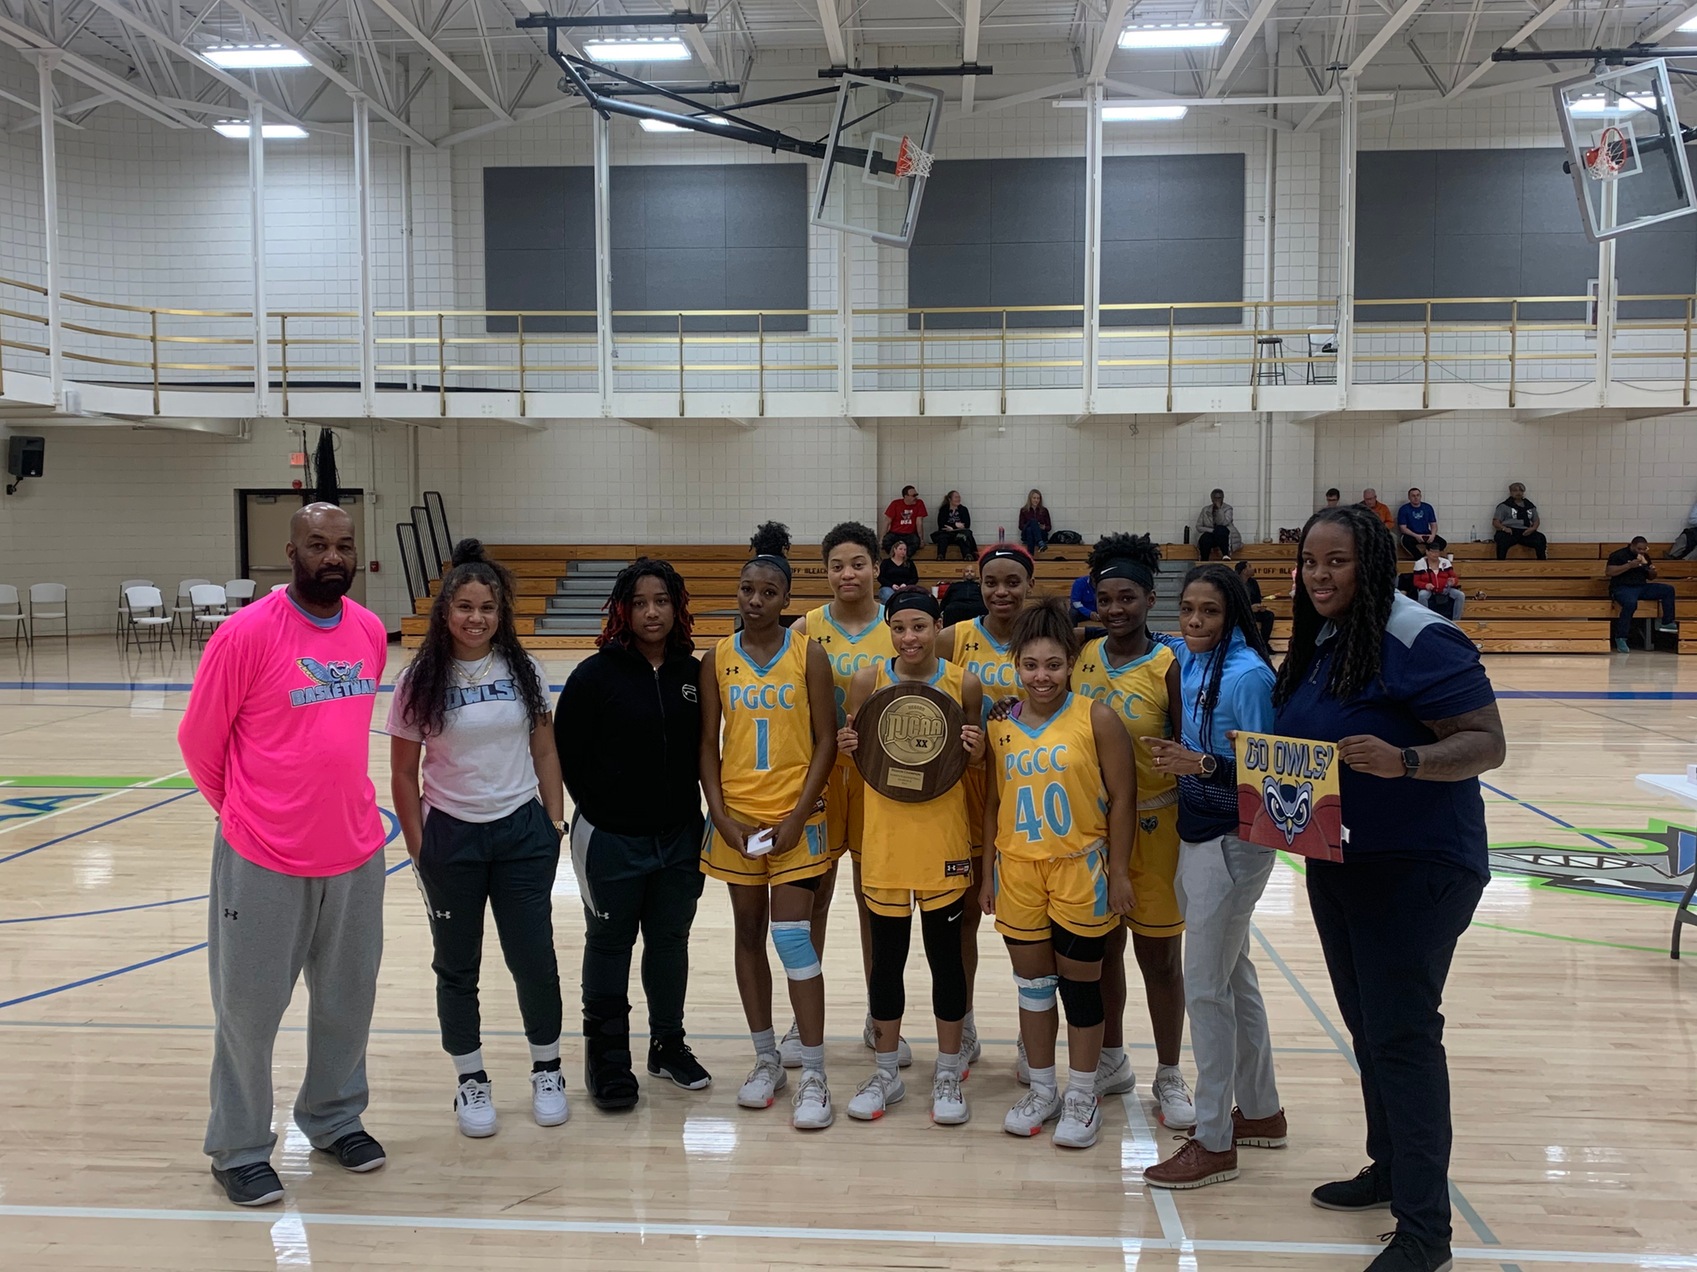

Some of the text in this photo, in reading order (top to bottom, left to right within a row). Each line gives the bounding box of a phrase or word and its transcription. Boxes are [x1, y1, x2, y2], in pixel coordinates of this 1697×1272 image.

[444, 679, 517, 711] OWLS
[728, 683, 795, 711] PGCC
[753, 718, 772, 771] 1
[916, 739, 928, 748] XX
[1245, 737, 1334, 780] GO OWLS!
[1005, 744, 1068, 781] PGCC
[1015, 781, 1072, 843] 40
